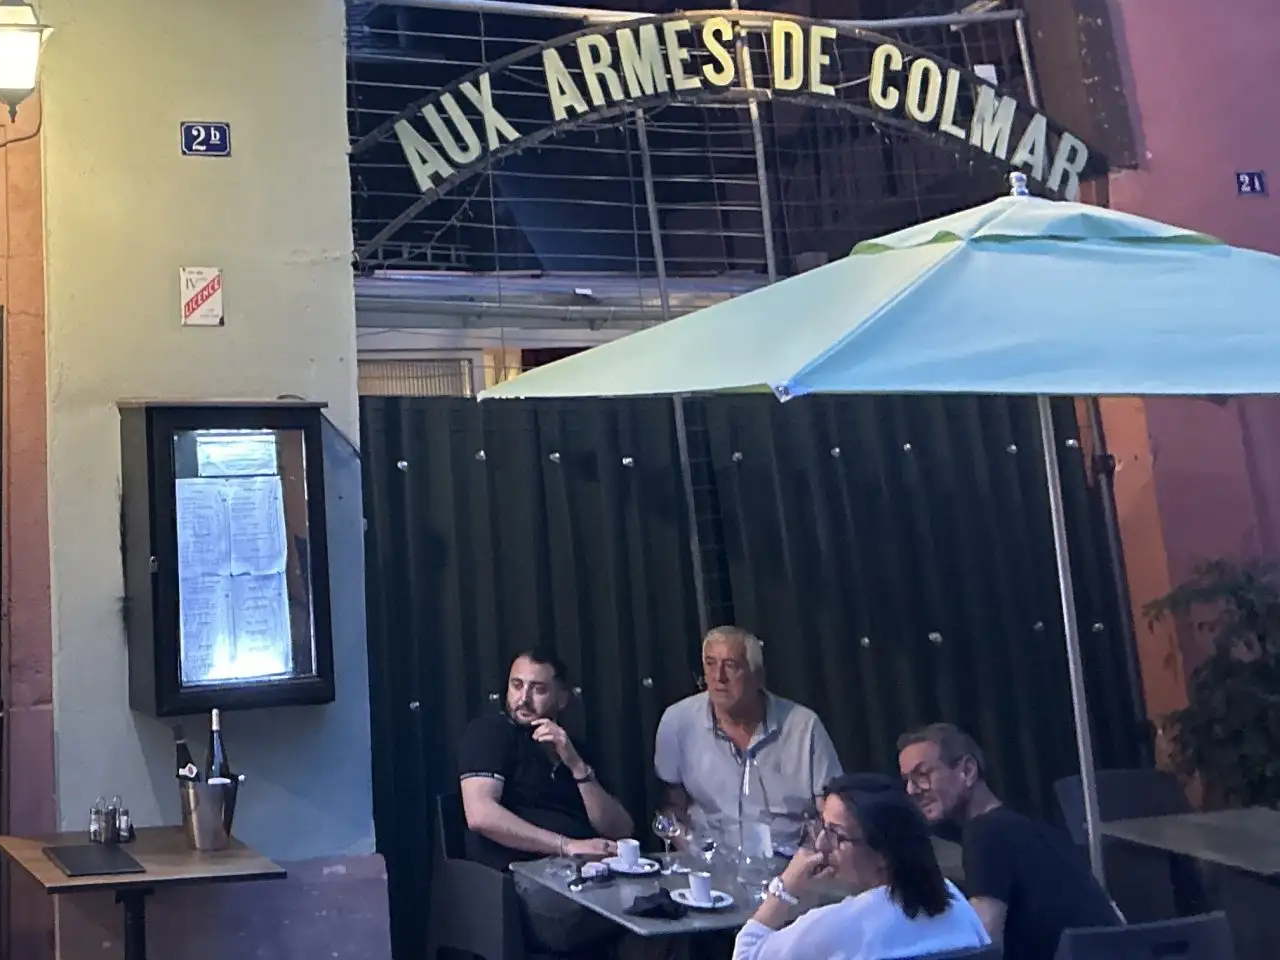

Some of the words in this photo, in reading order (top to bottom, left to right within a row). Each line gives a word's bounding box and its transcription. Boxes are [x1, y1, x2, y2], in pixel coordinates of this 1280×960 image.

[394, 72, 522, 192] AUX
[542, 17, 735, 122] ARMES
[772, 19, 837, 96] DE
[870, 44, 1089, 202] COLMAR
[184, 275, 221, 318] LICENCE
